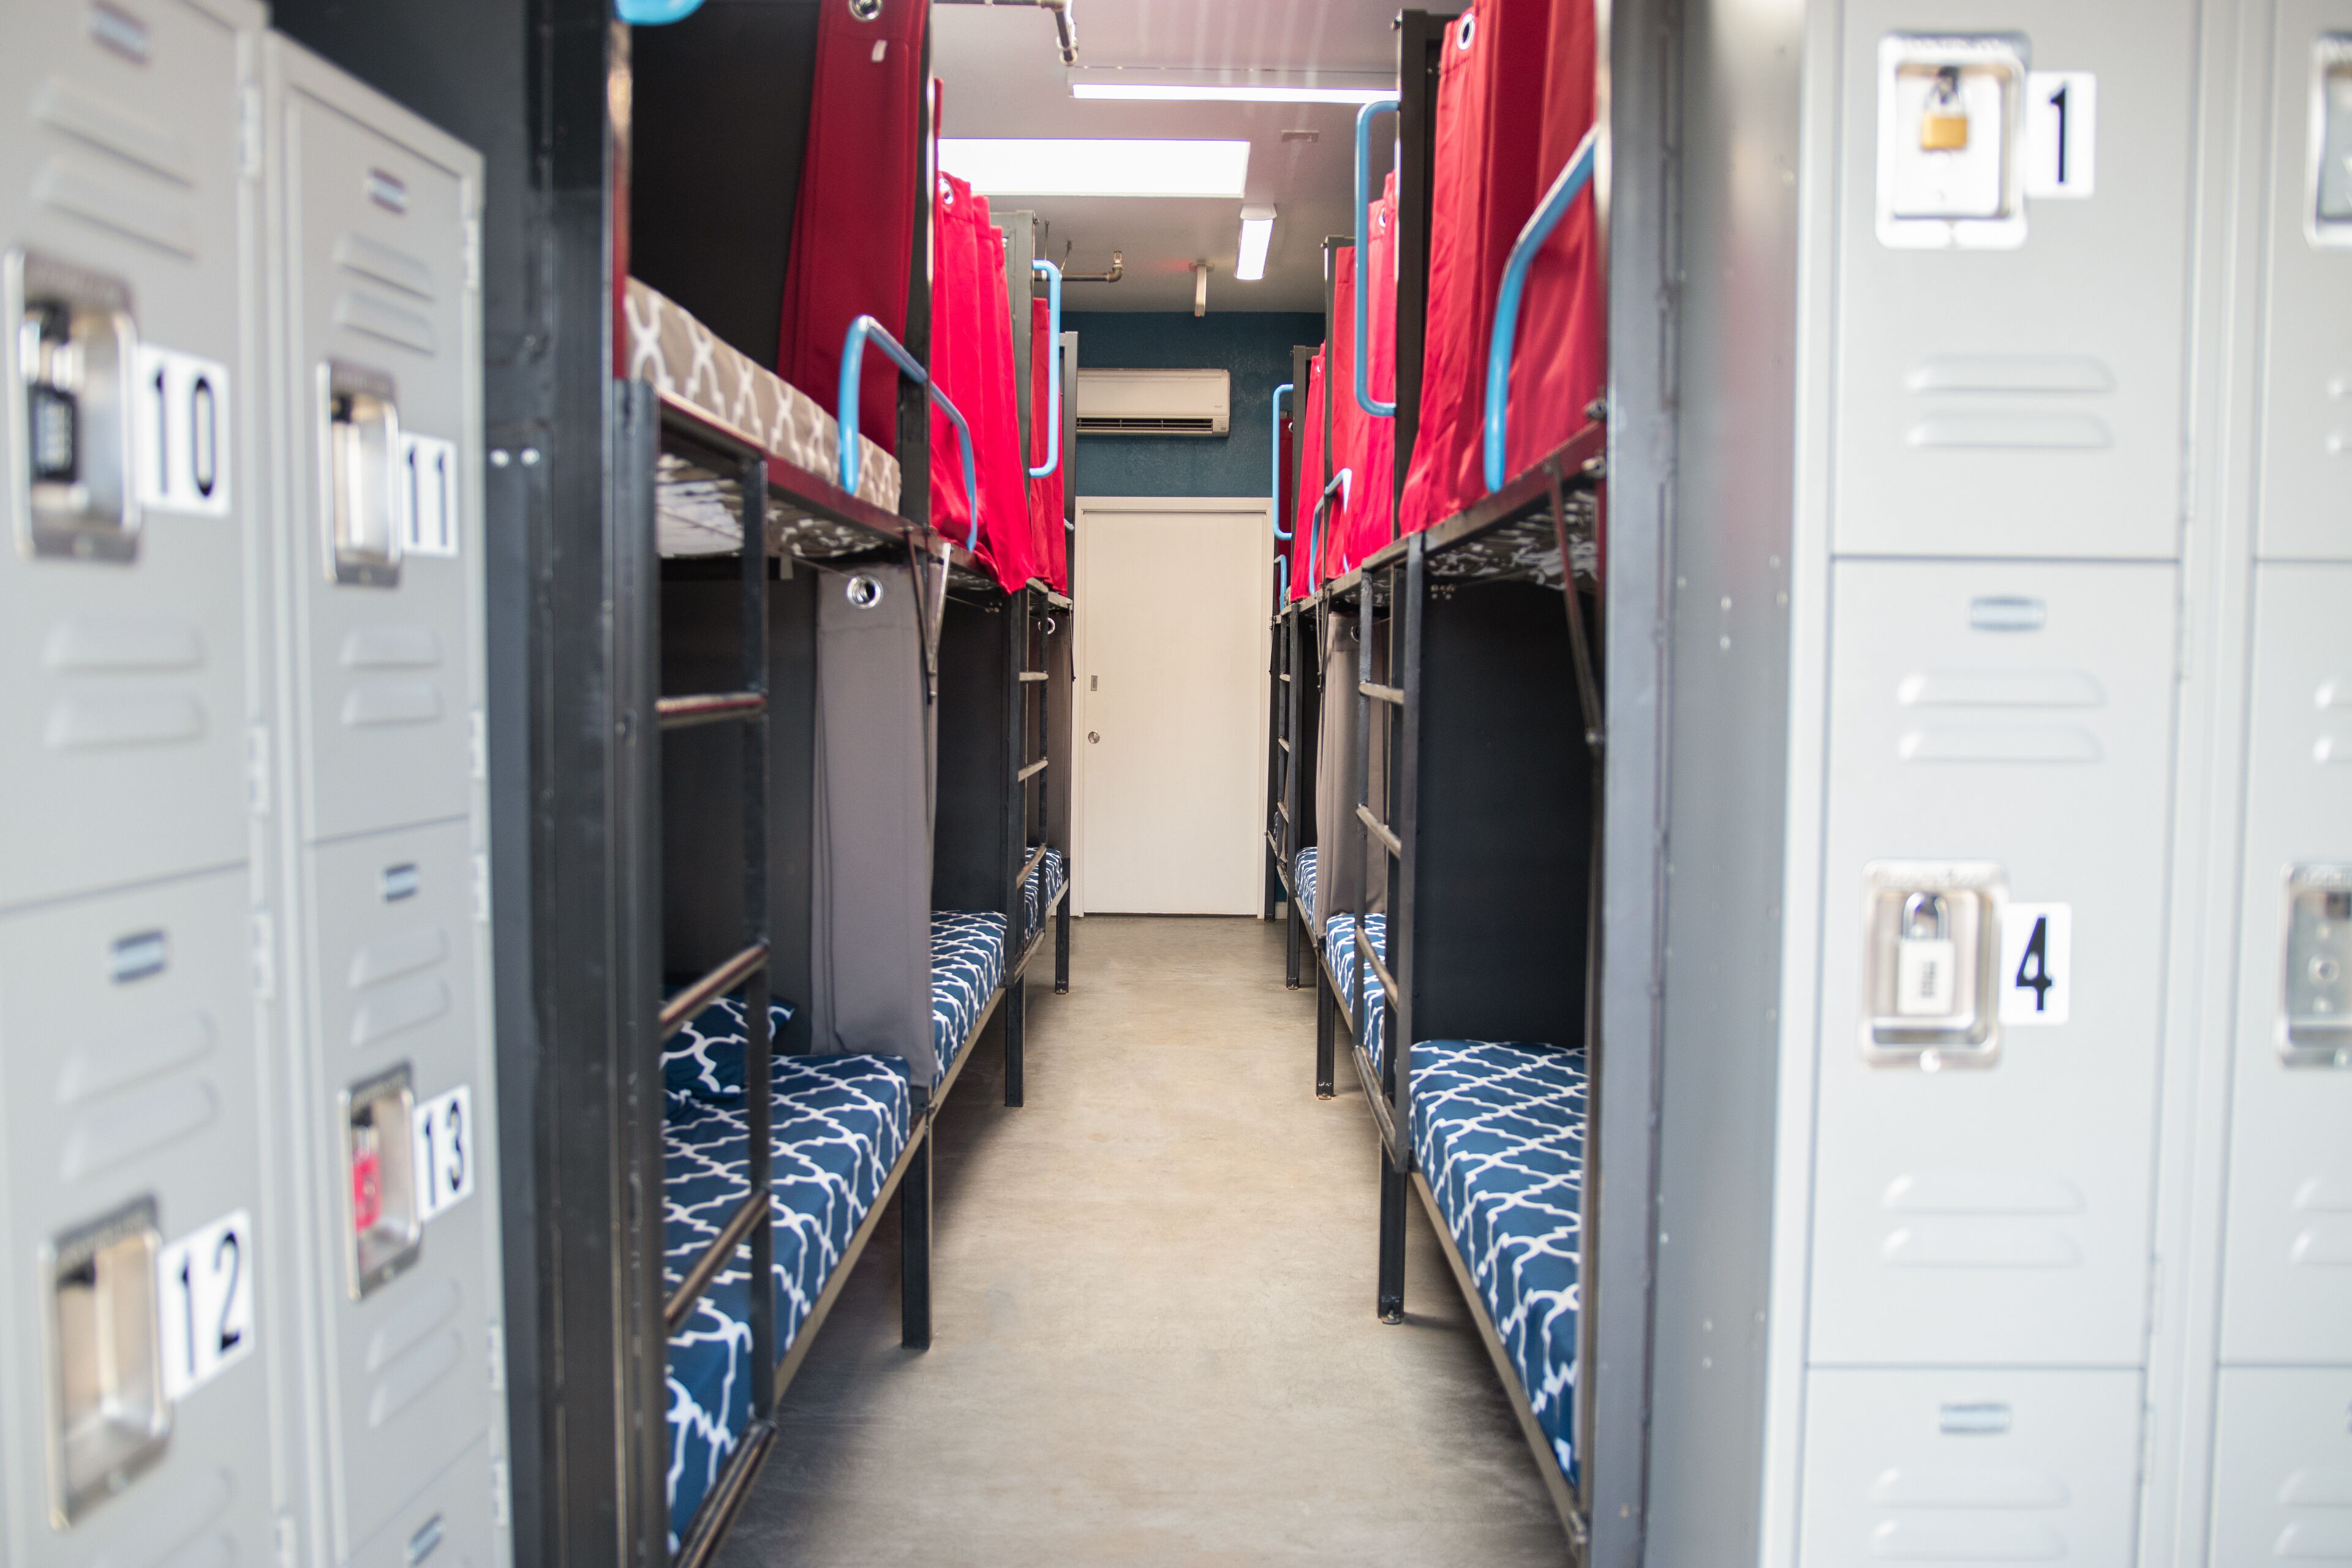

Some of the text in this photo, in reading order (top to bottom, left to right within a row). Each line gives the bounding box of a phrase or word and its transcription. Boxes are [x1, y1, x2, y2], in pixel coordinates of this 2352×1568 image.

[2049, 82, 2067, 184] 1
[153, 365, 216, 498] 10
[407, 445, 448, 546] 11
[2015, 913, 2053, 1011] 4
[423, 1100, 466, 1209] 13
[177, 1231, 241, 1378] 12
